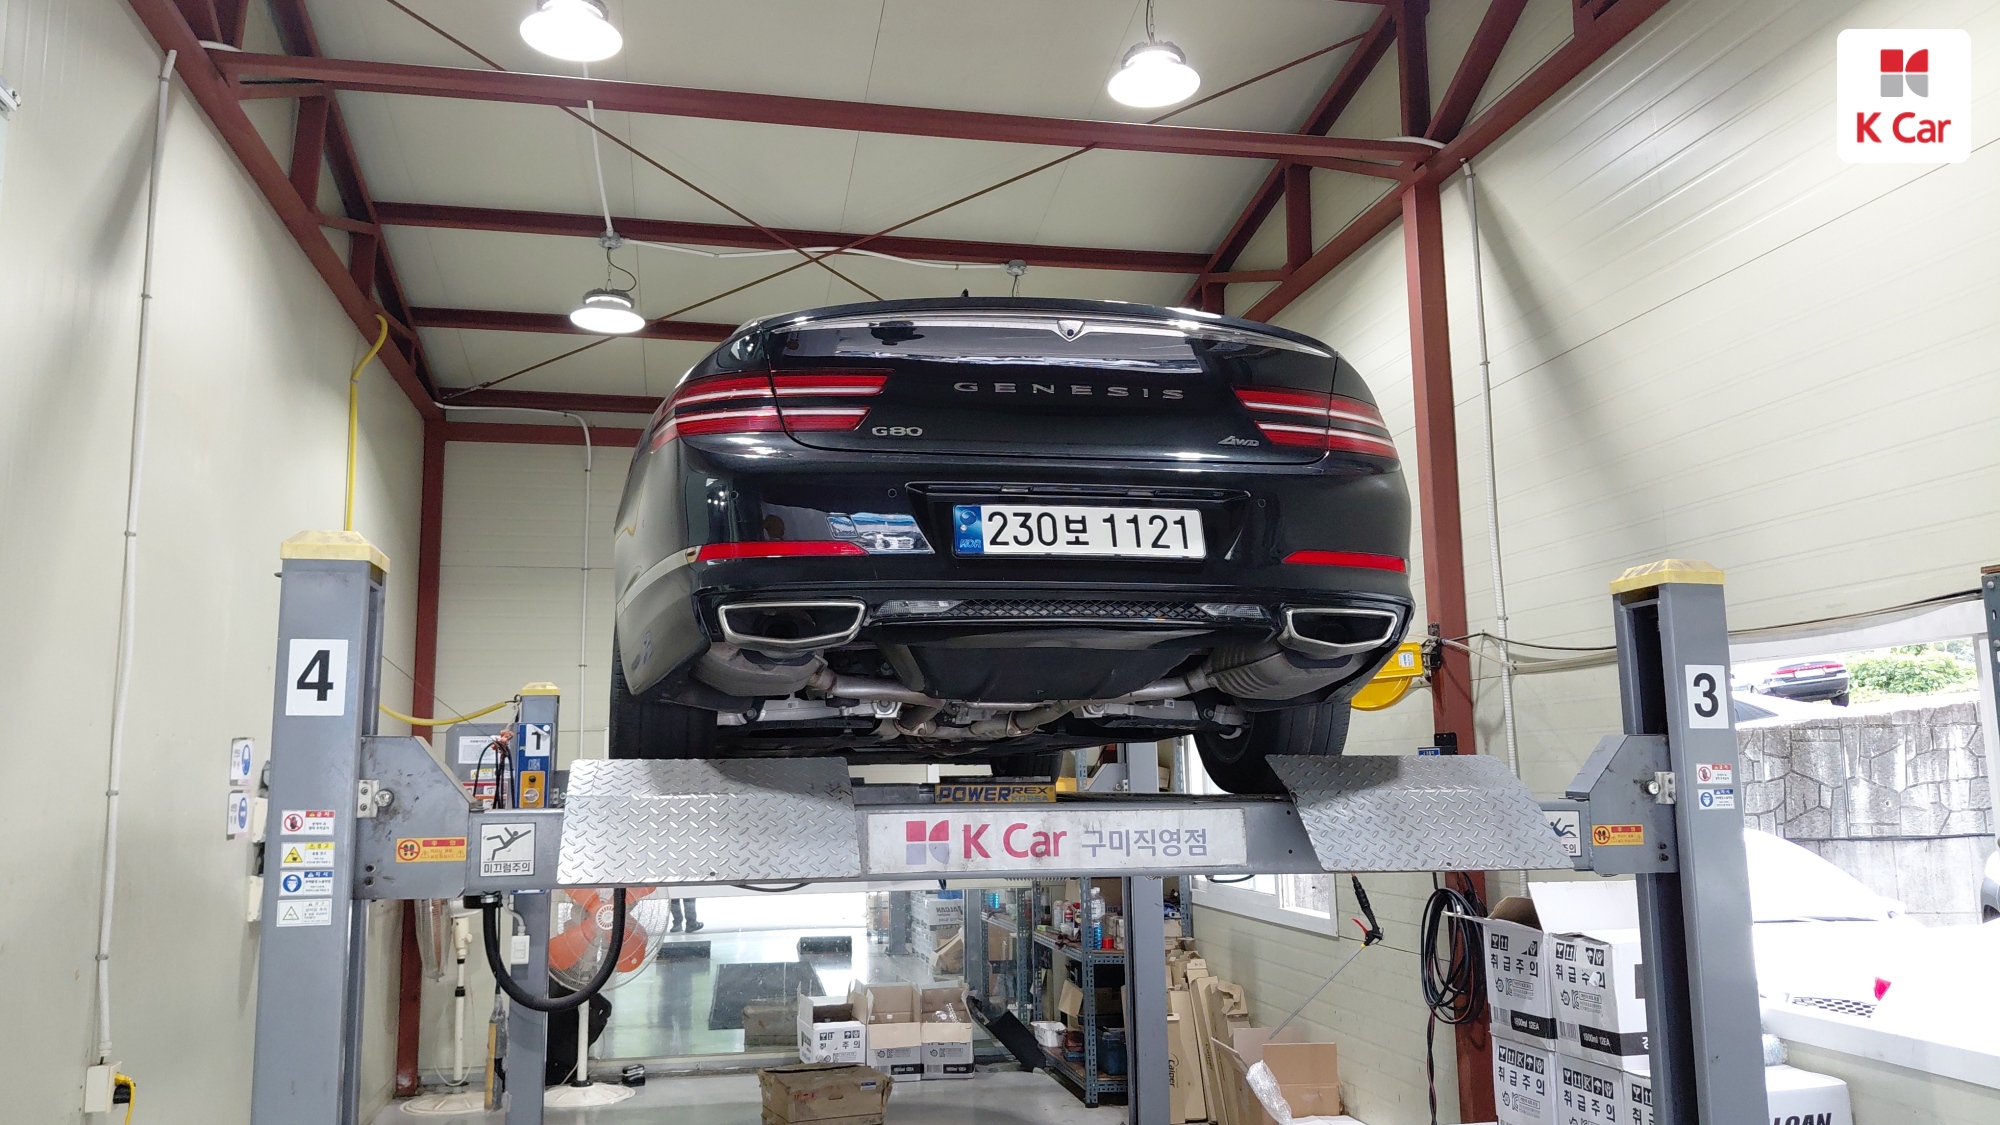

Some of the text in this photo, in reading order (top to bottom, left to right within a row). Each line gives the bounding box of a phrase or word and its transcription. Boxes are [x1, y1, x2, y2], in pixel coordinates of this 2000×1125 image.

[953, 382, 1184, 400] GENESIS
[871, 426, 923, 437] G80
[987, 511, 1189, 550] 230보 1121
[960, 538, 982, 549] KOR
[296, 649, 335, 702] 4
[1693, 672, 1719, 718] 3
[531, 731, 542, 750] 1
[939, 786, 1049, 802] POWER REX
[962, 822, 1208, 859] K Car 구미직영점
[483, 862, 531, 874] 미끄럼주의
[1490, 953, 1539, 978] 취급주의
[1498, 1065, 1546, 1097] 취급주의
[1563, 1089, 1617, 1124] 취급주의
